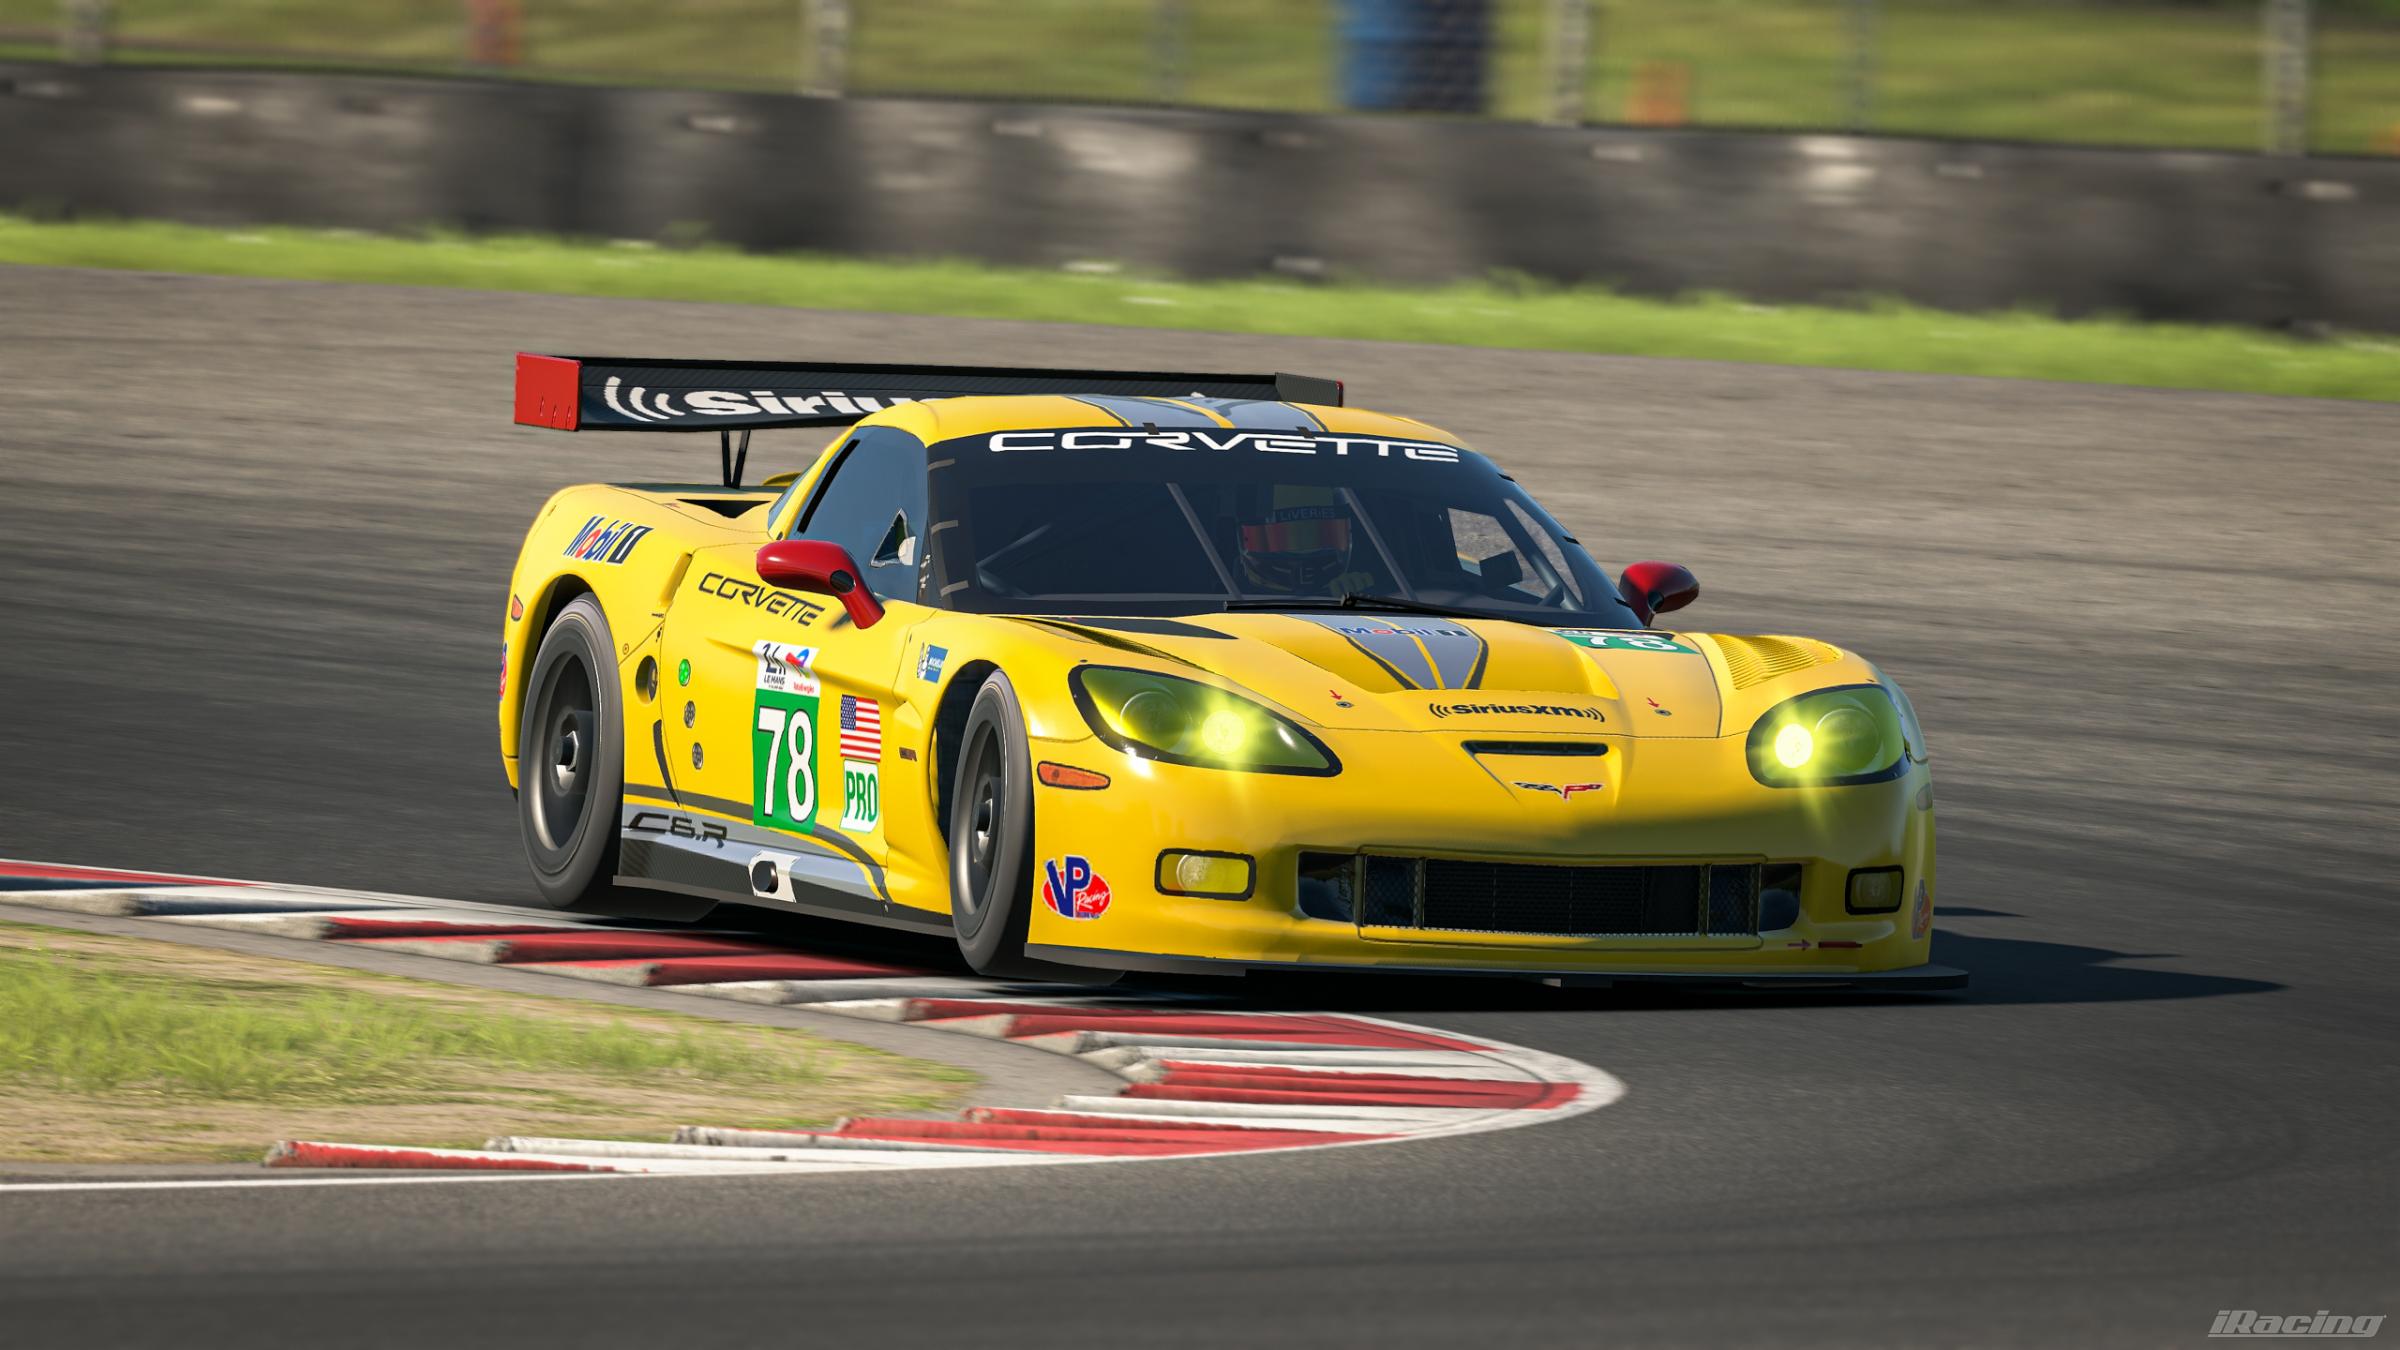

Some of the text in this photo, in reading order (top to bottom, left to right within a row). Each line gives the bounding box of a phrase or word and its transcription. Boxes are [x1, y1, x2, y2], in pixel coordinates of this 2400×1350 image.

[989, 432, 1460, 463] CORVETTE
[563, 514, 656, 565] Mobil 1
[698, 572, 826, 627] CORVETTE
[1339, 627, 1432, 636] Mobil
[764, 674, 786, 686] LE MANS
[757, 705, 816, 824] 78
[844, 770, 878, 822] PRO
[1045, 855, 1091, 919] VP
[1075, 890, 1109, 911] Racing
